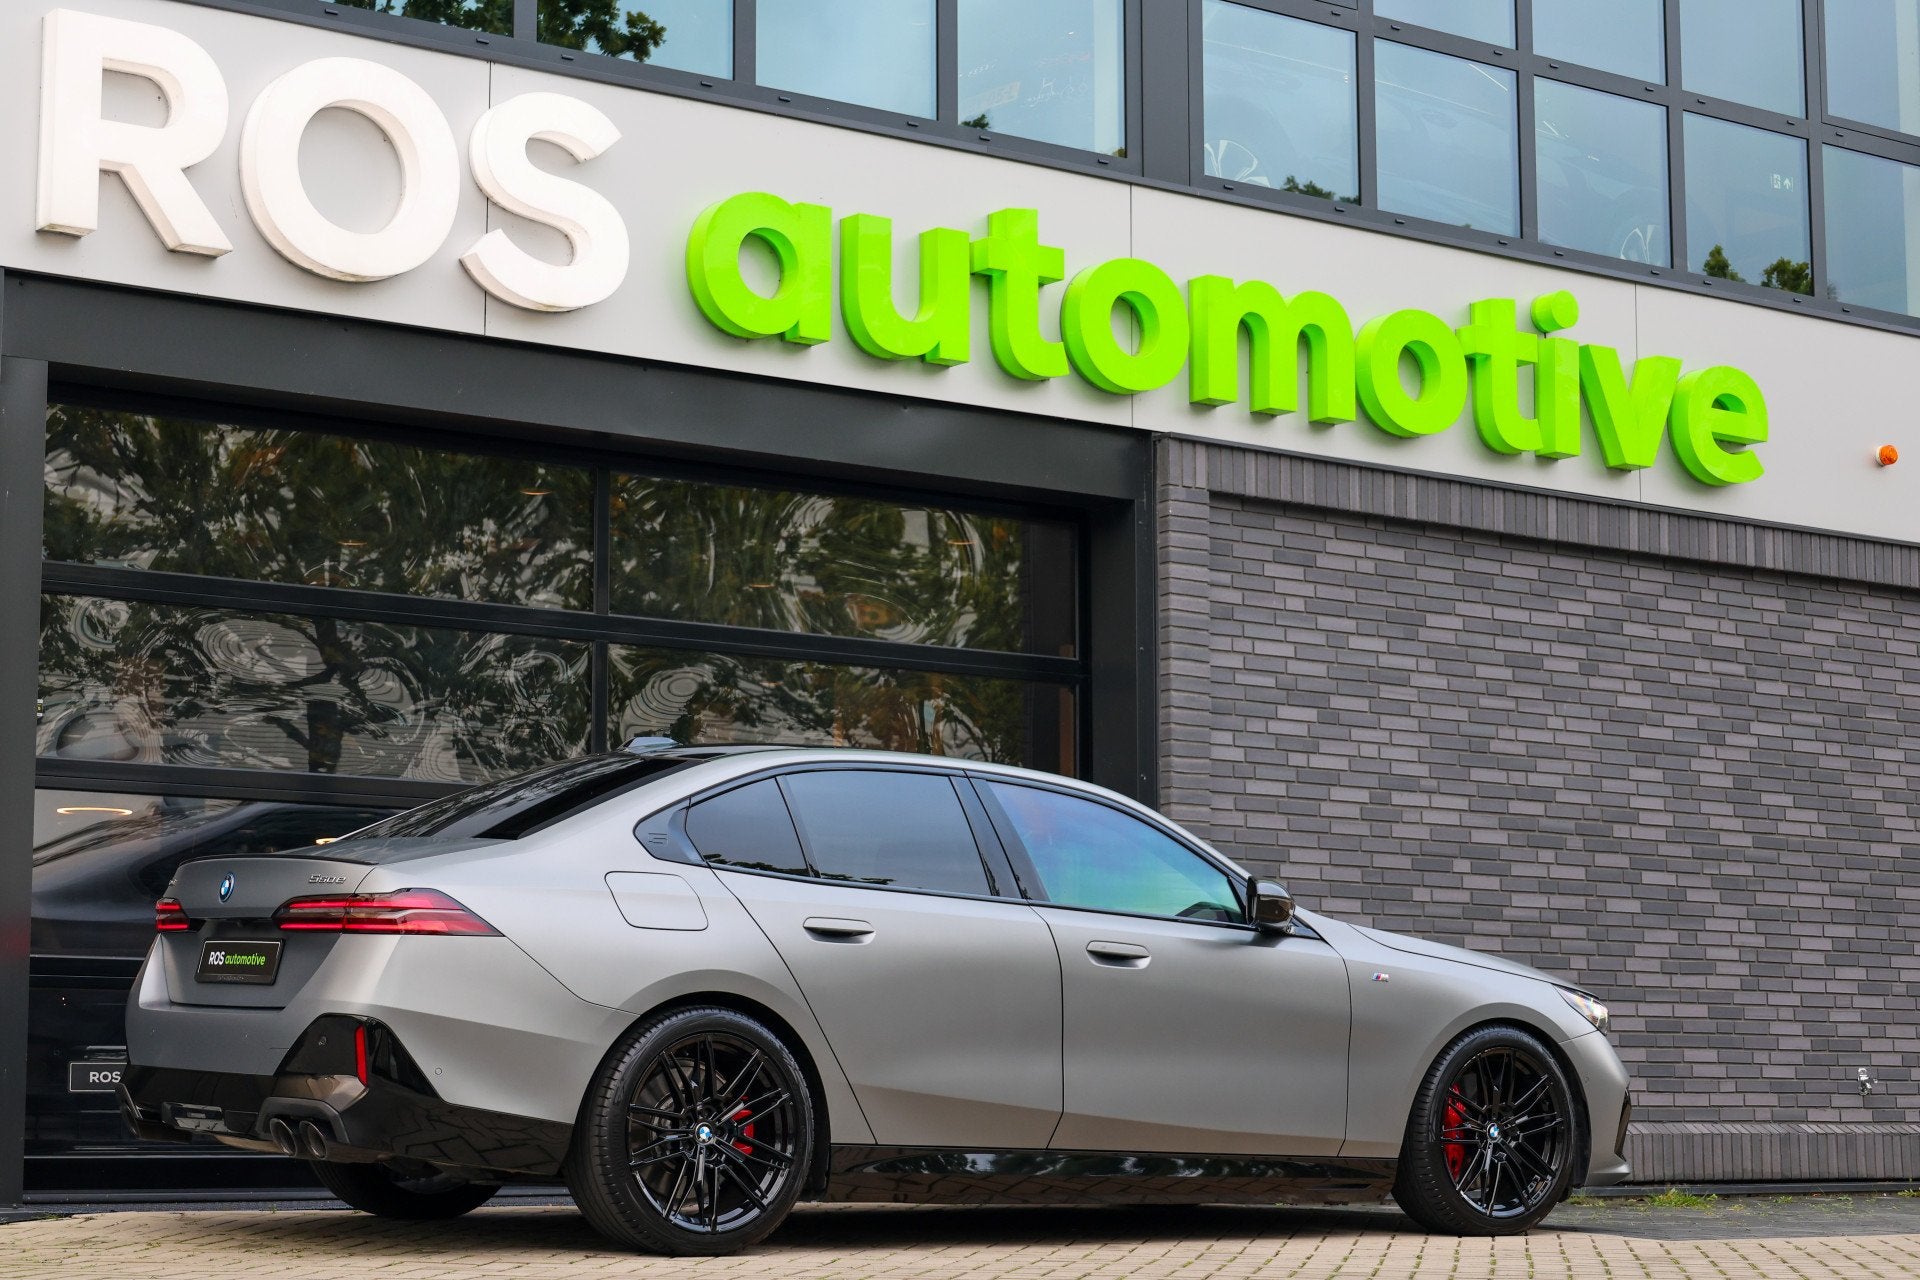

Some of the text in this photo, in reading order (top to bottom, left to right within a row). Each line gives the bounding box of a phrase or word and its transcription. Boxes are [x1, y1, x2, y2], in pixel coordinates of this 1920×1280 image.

[35, 8, 1768, 485] ROS automotive
[208, 951, 266, 966] ROS automotive
[89, 1071, 121, 1083] ROS
